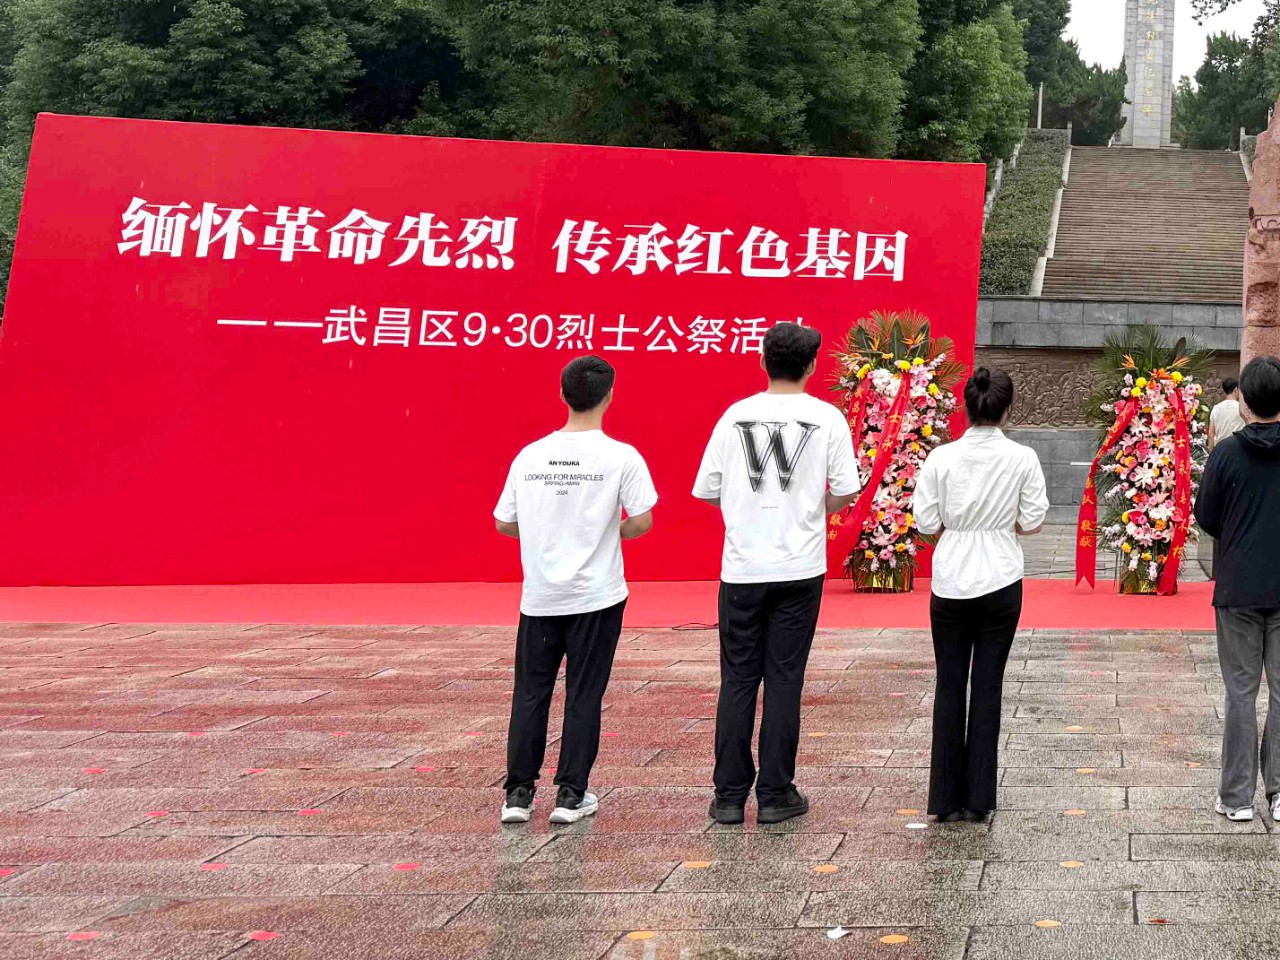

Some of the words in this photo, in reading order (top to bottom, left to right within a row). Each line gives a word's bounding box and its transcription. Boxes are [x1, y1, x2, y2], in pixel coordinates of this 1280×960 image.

[117, 197, 519, 271] 缅怀革命先烈
[551, 218, 909, 282] 传承红色基因
[216, 305, 811, 356] ——武昌区9·30烈士公祭活
[524, 473, 552, 482] LOOKING
[553, 473, 569, 481] FOR
[569, 474, 604, 482] MIRACLES
[733, 420, 821, 493] W
